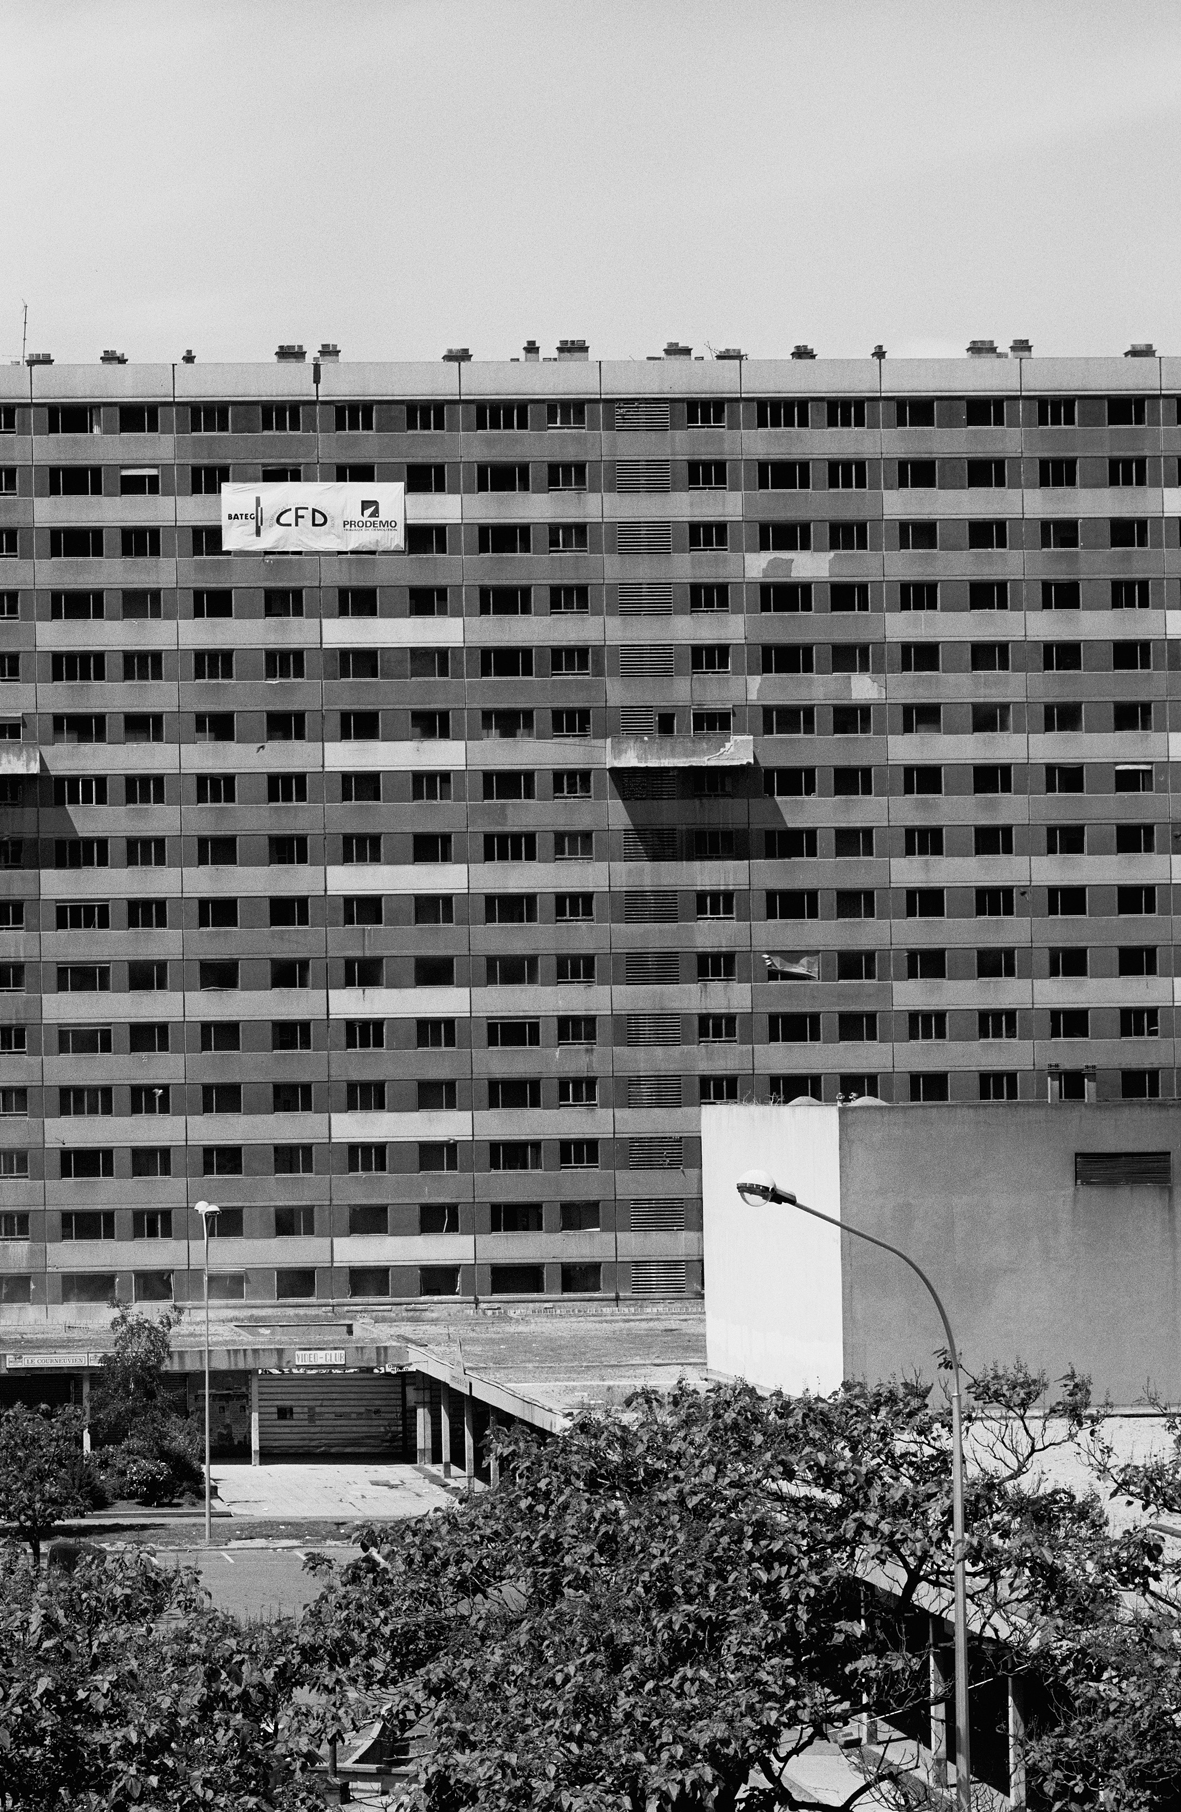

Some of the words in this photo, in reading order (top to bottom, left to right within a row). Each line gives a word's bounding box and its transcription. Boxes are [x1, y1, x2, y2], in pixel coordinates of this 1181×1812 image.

[227, 512, 256, 521] BATEG
[275, 506, 328, 527] CFD
[342, 519, 398, 529] PRODEMO
[37, 1357, 84, 1365] COURNEUVIEN
[296, 1352, 346, 1364] VIDEO-CLUB
